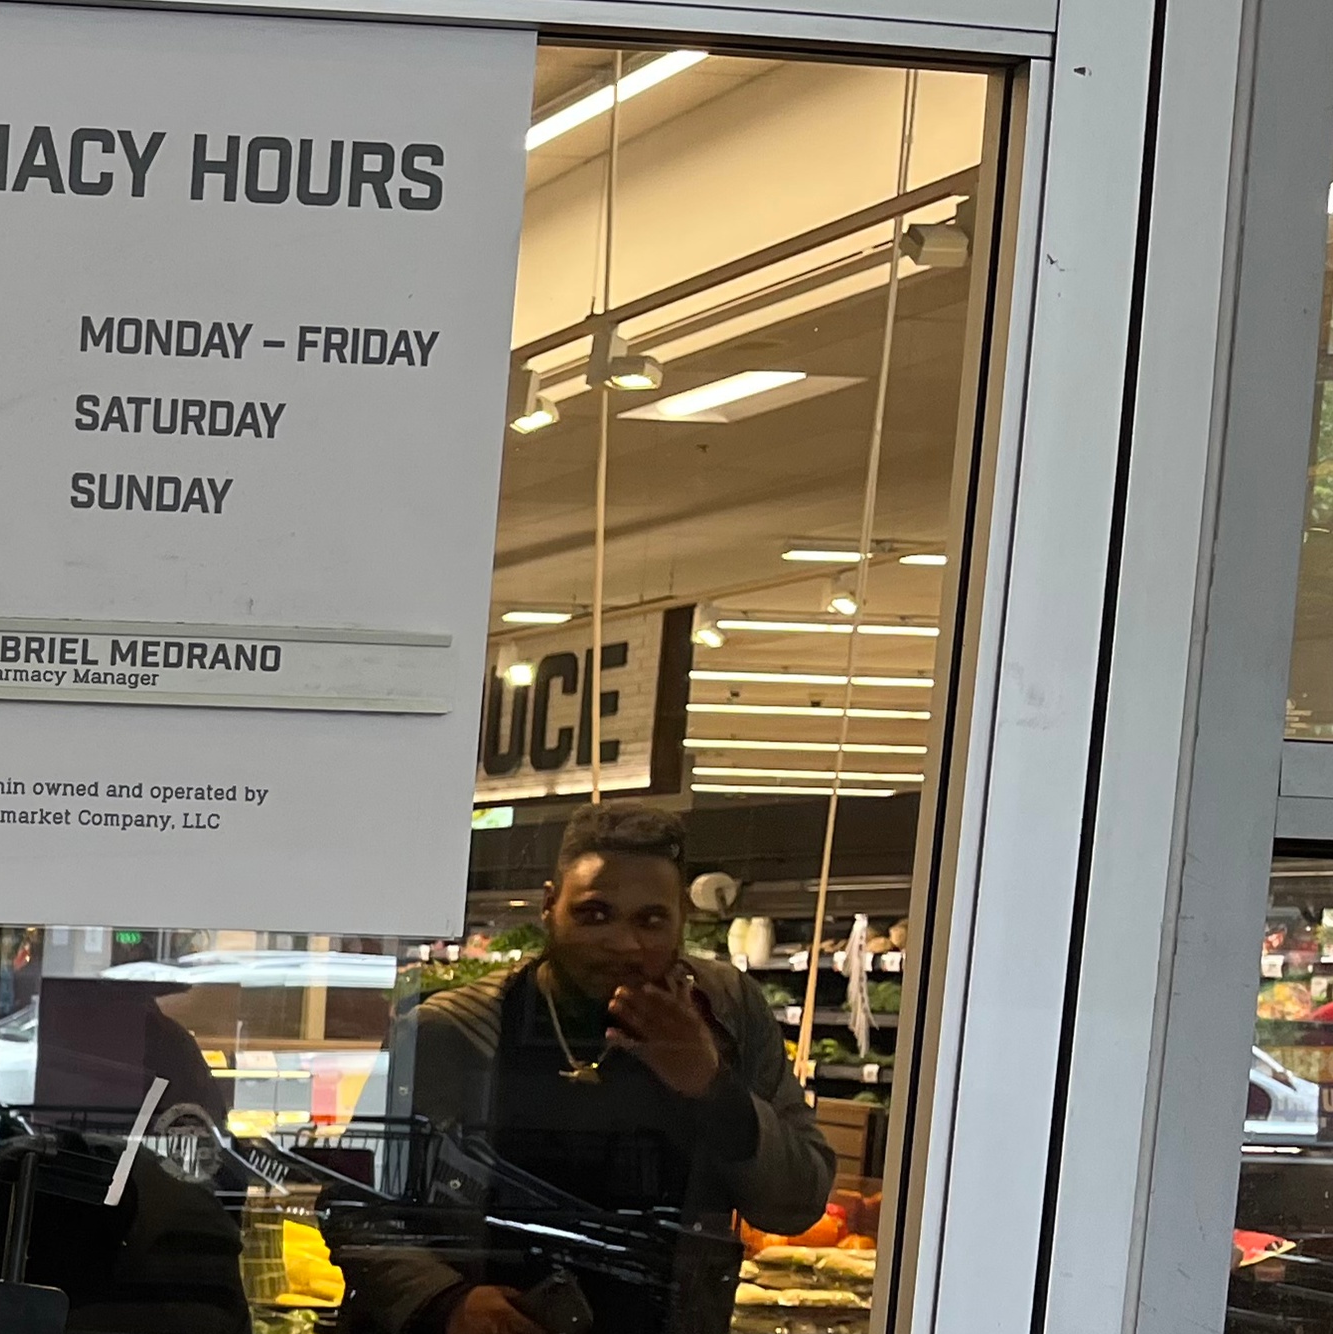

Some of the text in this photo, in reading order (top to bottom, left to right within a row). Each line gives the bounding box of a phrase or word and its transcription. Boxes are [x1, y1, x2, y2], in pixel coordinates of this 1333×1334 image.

[191, 134, 444, 210] HOURS
[80, 316, 253, 359] MONDAY
[297, 326, 439, 366] FRIDAY
[75, 395, 286, 438] SATURDAY
[71, 473, 233, 514] SUNDAY
[110, 640, 281, 671] MEDRANO
[73, 669, 161, 690] Manager
[479, 643, 628, 775] UCE
[33, 782, 98, 797] owned
[106, 783, 142, 798] and
[150, 785, 236, 803] operated
[245, 787, 268, 806] by
[79, 810, 174, 831] Company,
[182, 813, 220, 829] LLC
